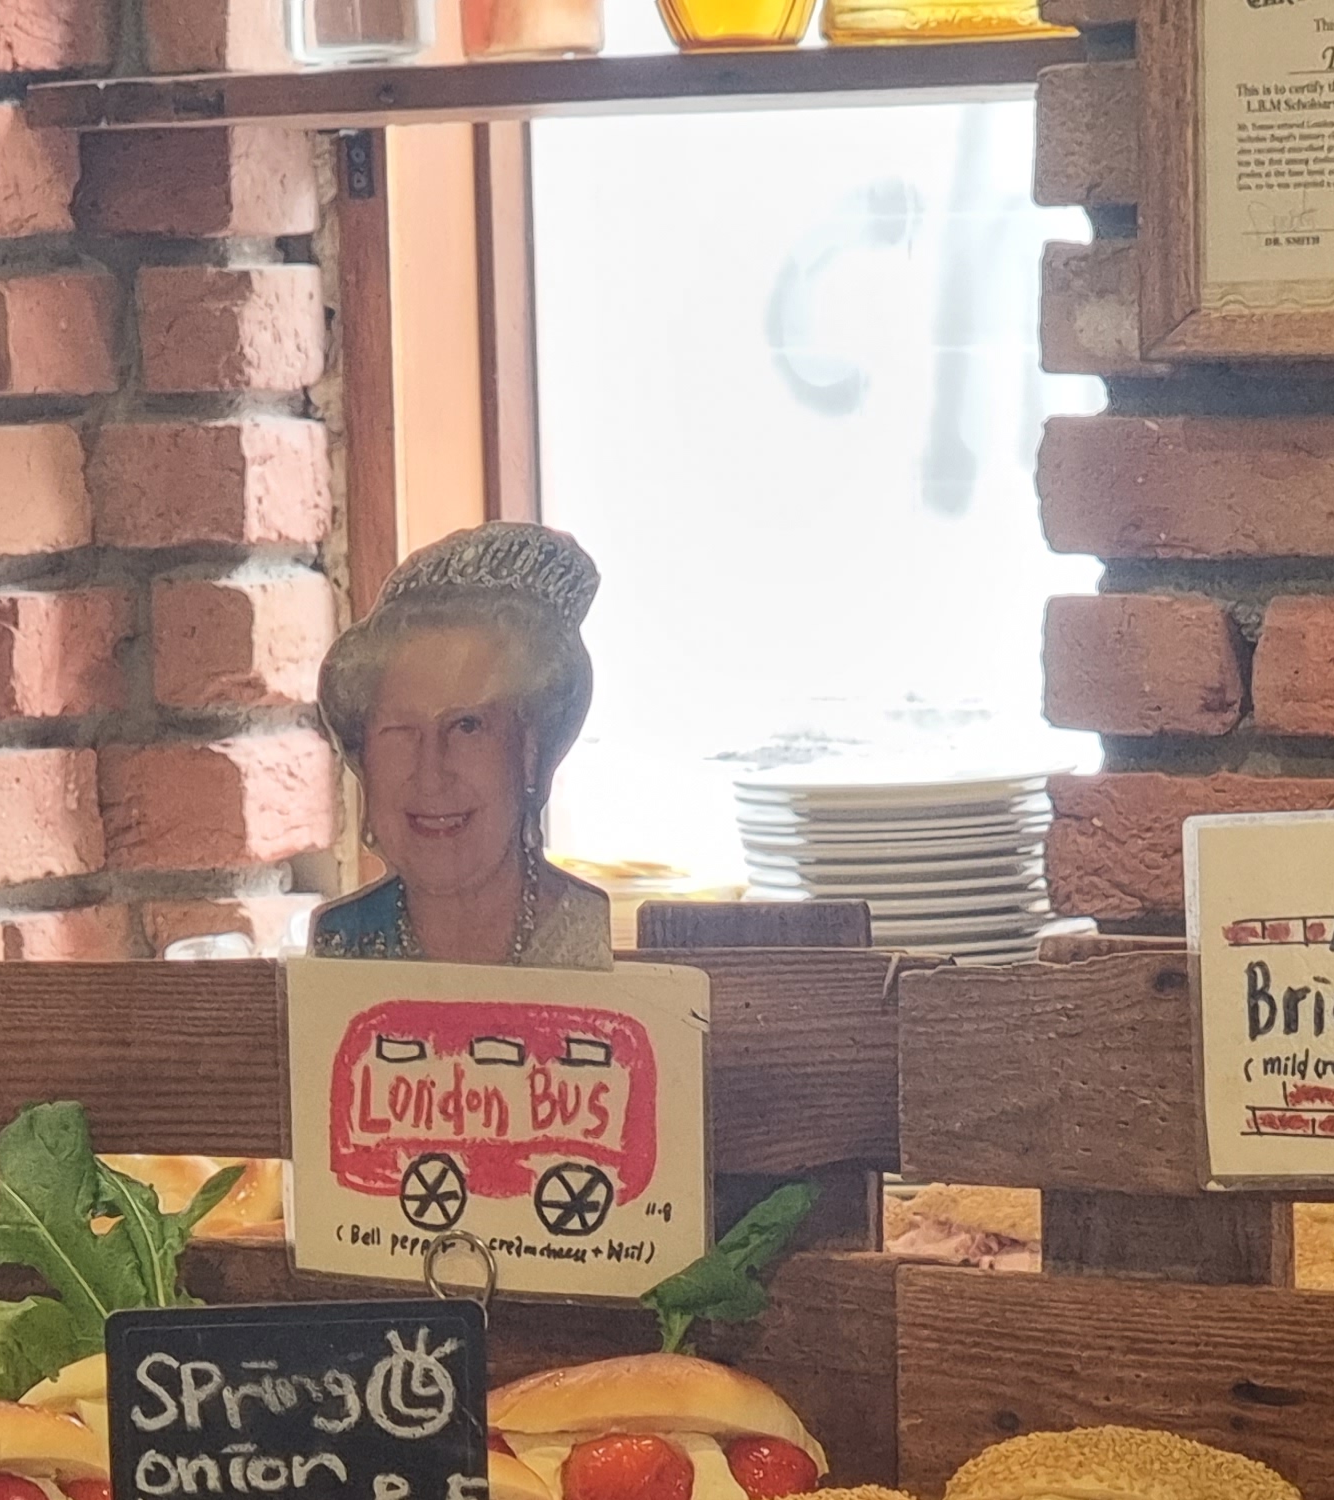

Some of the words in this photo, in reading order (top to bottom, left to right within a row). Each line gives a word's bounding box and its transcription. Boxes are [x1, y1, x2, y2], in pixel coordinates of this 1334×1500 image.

[1236, 83, 1260, 97] This
[1262, 84, 1272, 96] is
[1274, 83, 1287, 95] to
[1289, 80, 1325, 97] certify
[358, 1063, 510, 1138] London
[135, 1441, 348, 1496] onion
